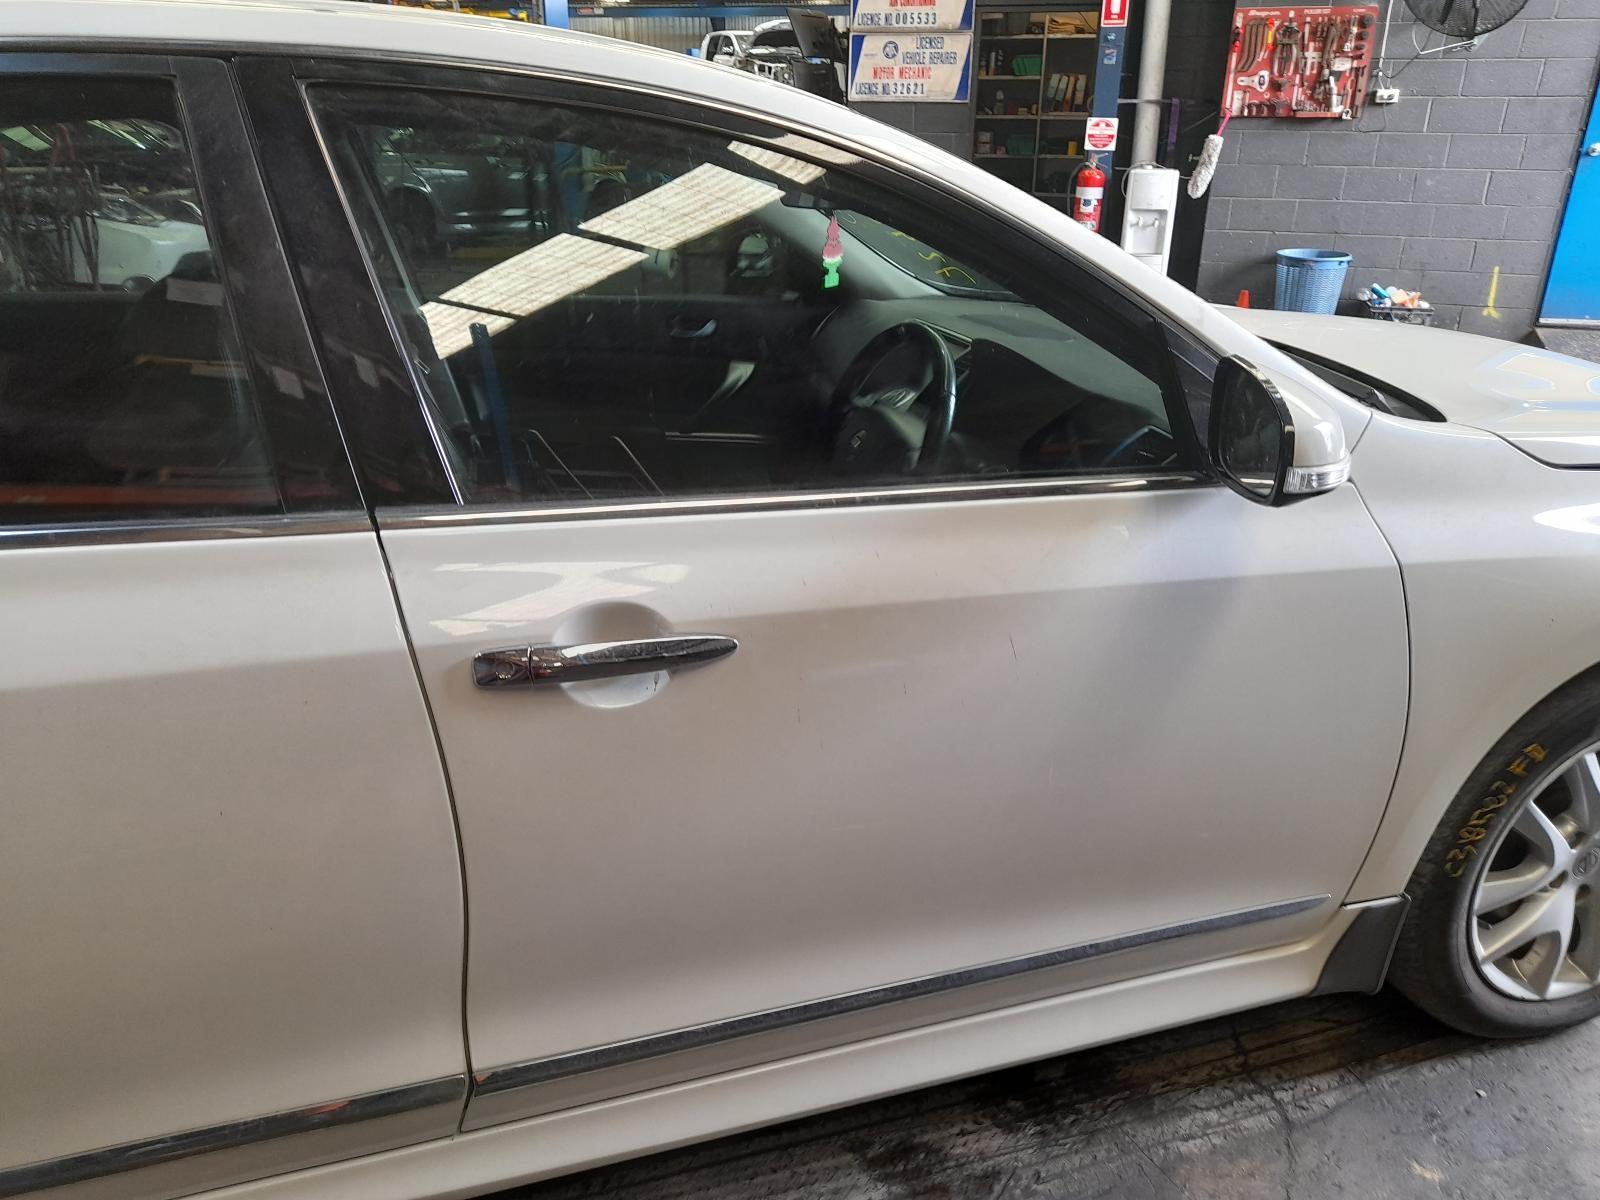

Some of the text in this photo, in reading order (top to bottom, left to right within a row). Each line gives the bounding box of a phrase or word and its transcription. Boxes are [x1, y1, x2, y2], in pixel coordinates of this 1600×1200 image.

[895, 12, 937, 25] 005533
[902, 51, 958, 65] VEHICLE REPAIRER
[873, 66, 932, 80] MOTOR MECHANIC
[893, 82, 925, 95] 32621
